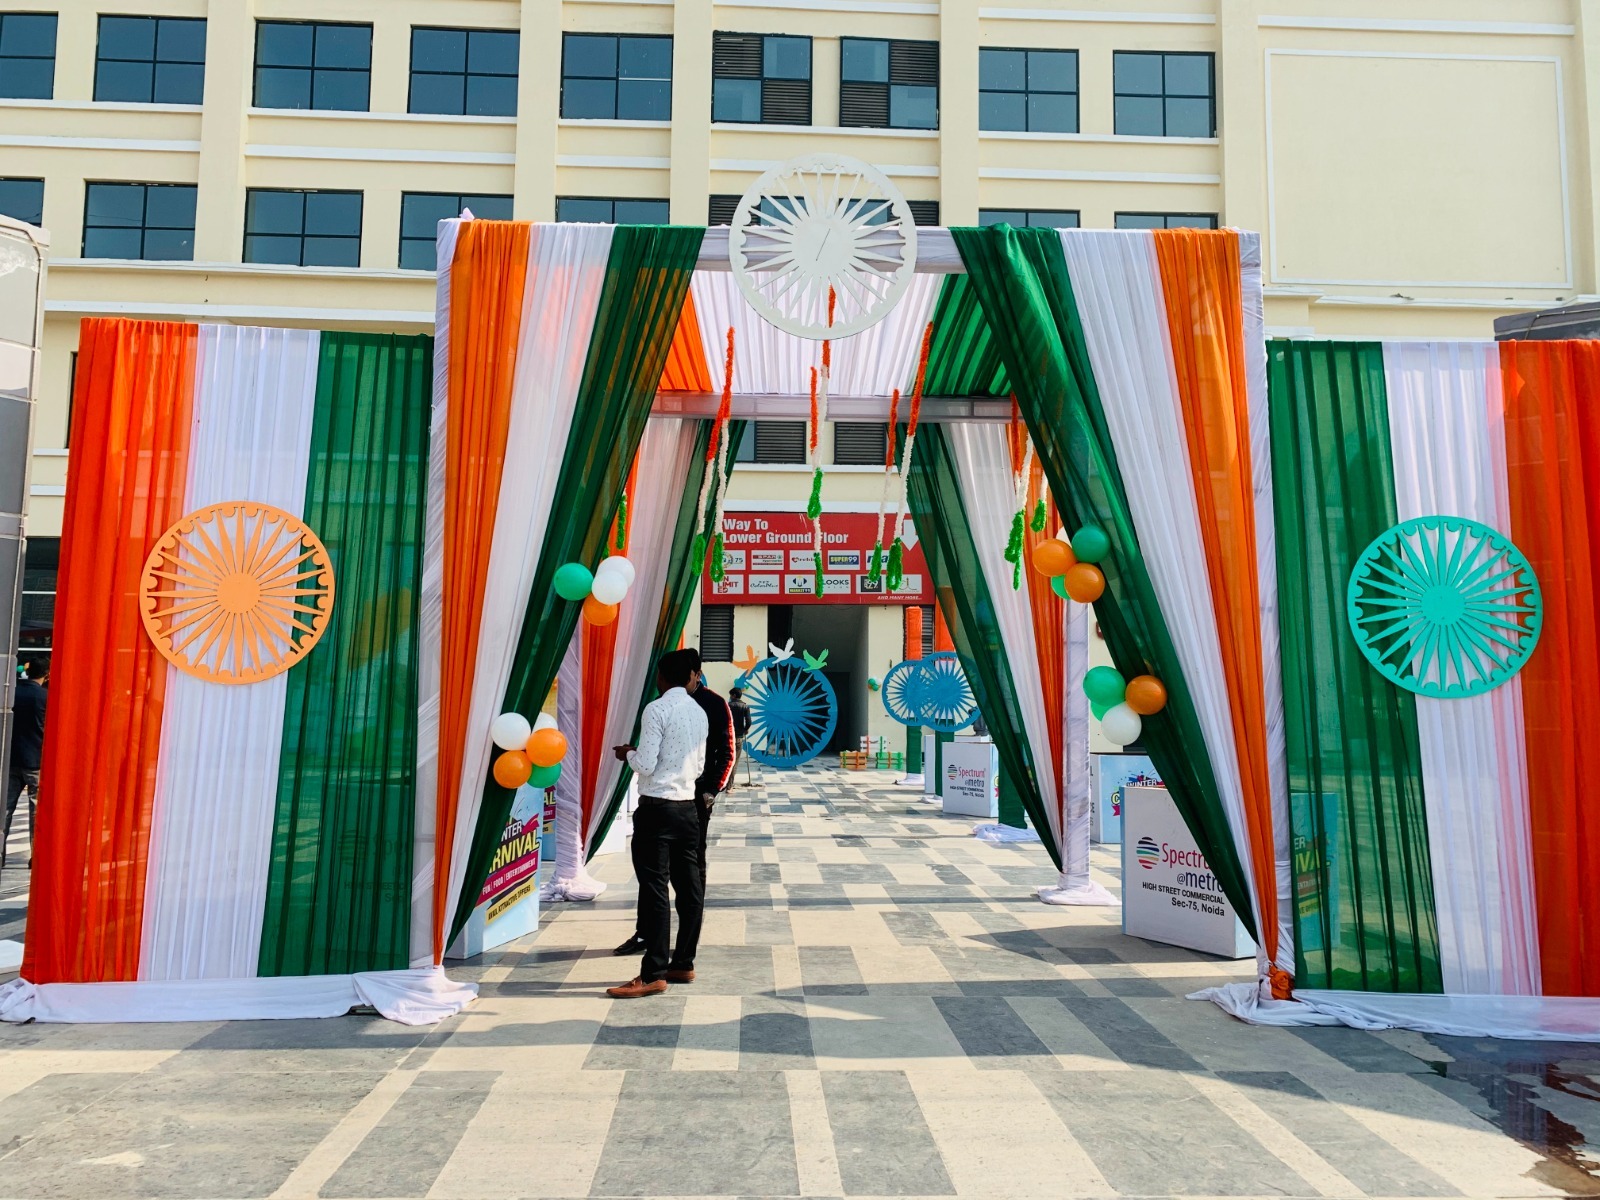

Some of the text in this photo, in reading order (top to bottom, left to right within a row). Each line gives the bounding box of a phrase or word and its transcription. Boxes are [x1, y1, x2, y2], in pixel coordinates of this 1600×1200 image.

[723, 518, 768, 531] Way To
[723, 532, 762, 543] Lower
[766, 532, 812, 543] Ground
[959, 766, 985, 778] Spectrum
[501, 820, 522, 842] NTER
[489, 829, 540, 874] RNIVAL
[1162, 843, 1211, 870] Spectru
[482, 857, 536, 896] FUN FOOD ENTERTAINMENT
[1142, 881, 1225, 905] HIGH STREET COMMERCIAL
[498, 895, 518, 915] ATTRACTIVE
[1171, 897, 1225, 916] Sec-75, Noida
